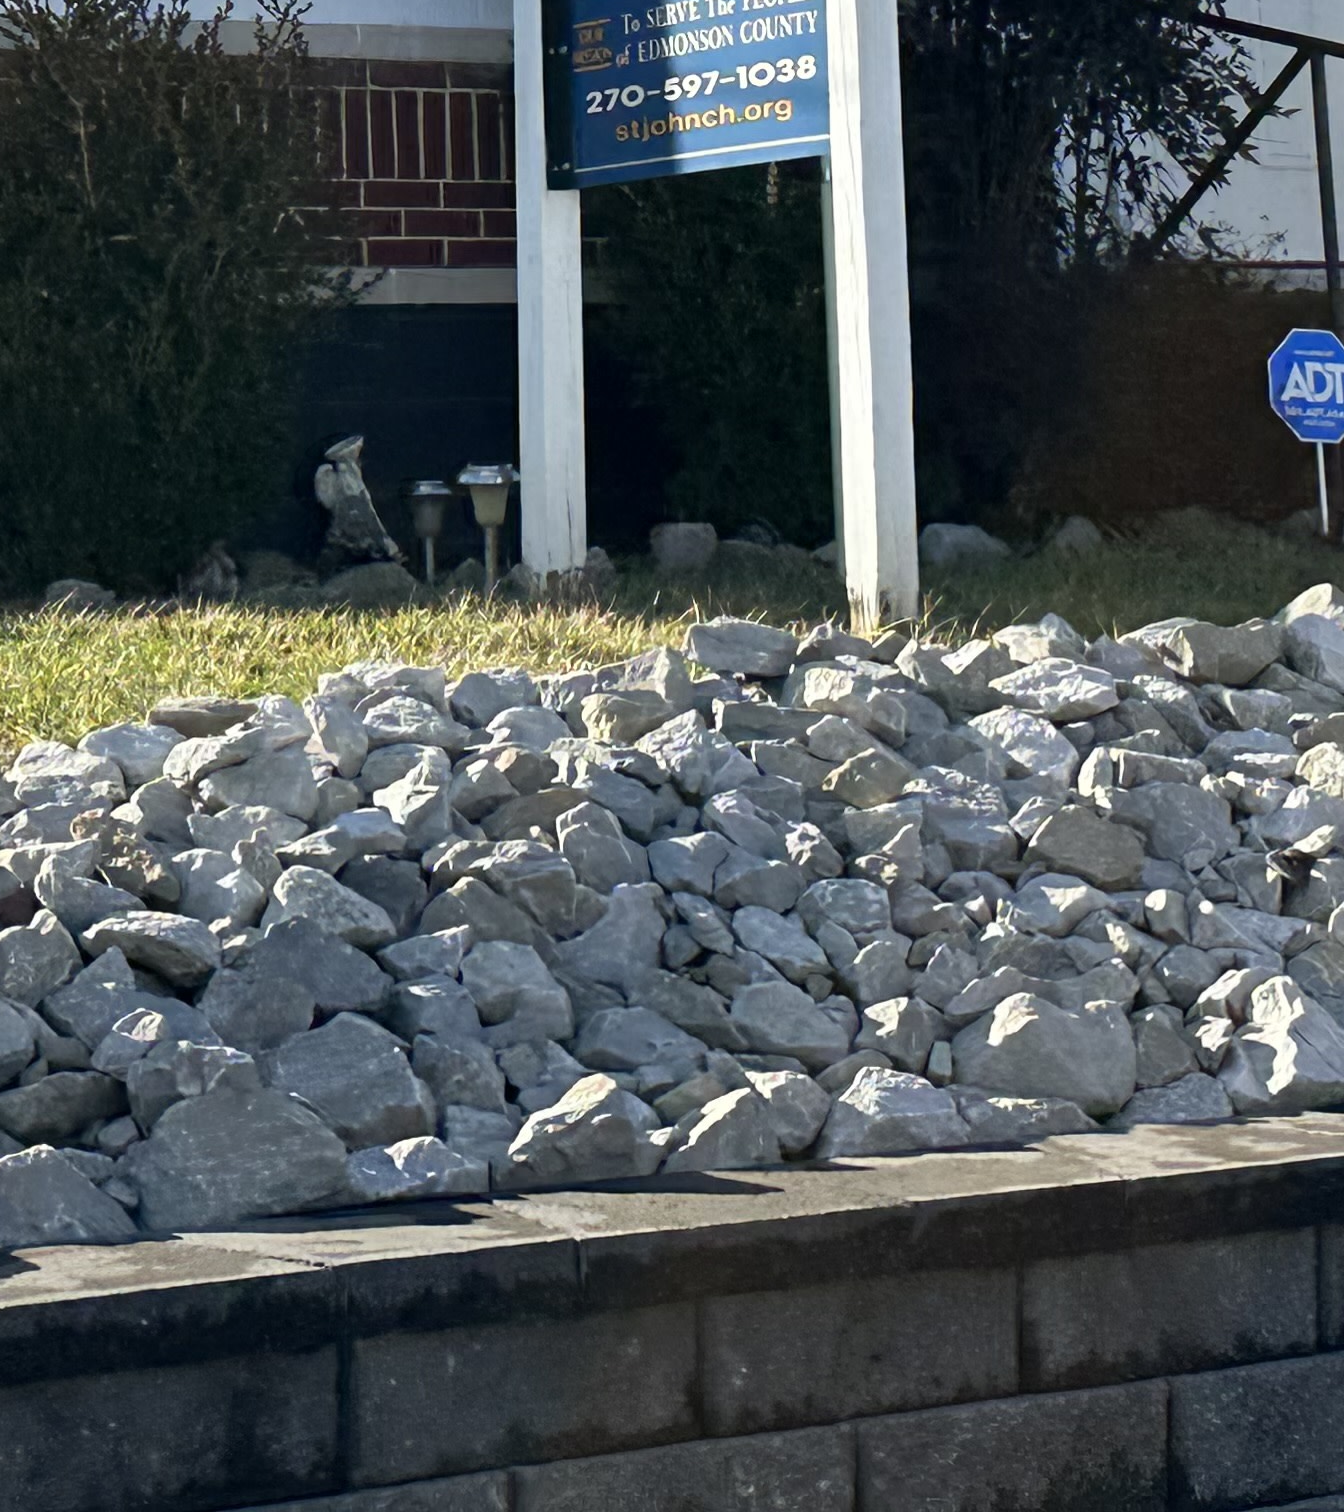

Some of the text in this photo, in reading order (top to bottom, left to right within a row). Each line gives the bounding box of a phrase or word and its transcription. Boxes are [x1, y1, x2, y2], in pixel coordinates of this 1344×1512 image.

[620, 13, 641, 35] To
[638, 24, 734, 63] EDMONSON
[740, 10, 818, 44] COUNTY
[586, 54, 817, 114] 270-597-1038
[615, 98, 794, 142] stjohnch.org
